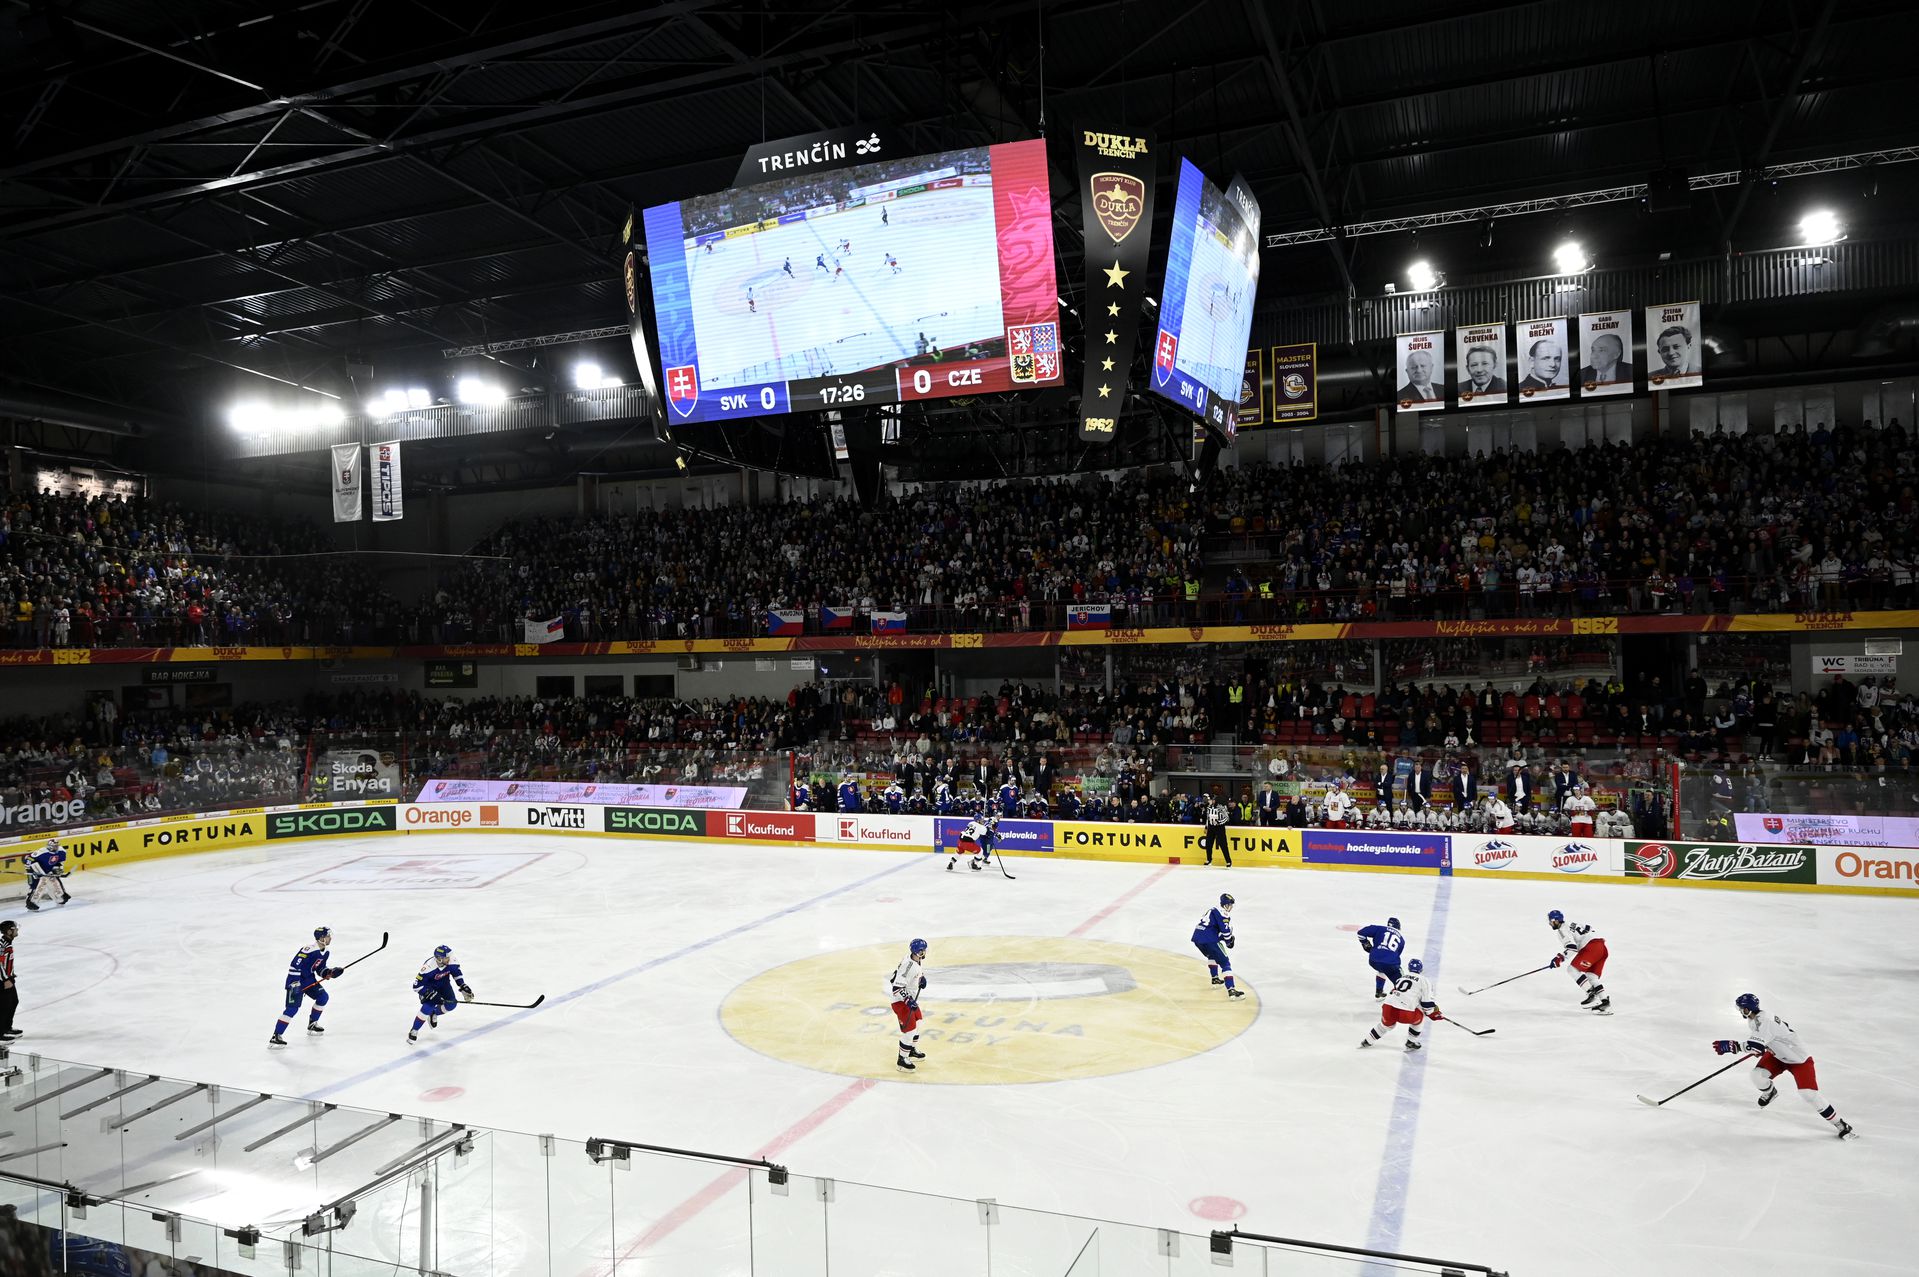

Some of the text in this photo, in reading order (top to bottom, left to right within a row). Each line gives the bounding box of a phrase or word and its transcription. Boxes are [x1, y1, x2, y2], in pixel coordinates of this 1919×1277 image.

[1084, 131, 1148, 153] DUKLA
[758, 140, 846, 172] TRENČÍN
[1100, 200, 1136, 212] DUKLA
[1277, 354, 1311, 363] MAJSTER
[720, 369, 982, 410] SVK 0 17:26 0 CZE
[1181, 381, 1193, 400] SVK
[1196, 386, 1203, 408] 0
[1085, 418, 1114, 432] 1962
[381, 464, 392, 513] TIPOS
[1794, 611, 1854, 623] DUKLA
[1104, 629, 1145, 638] DUKLA
[1250, 624, 1294, 634] DUKLA
[1543, 620, 1559, 632] od
[1570, 617, 1619, 635] 1962
[723, 639, 754, 647] DUKLA
[950, 633, 983, 648] 1962
[51, 649, 90, 665] 1962
[213, 648, 247, 656] DUKLA
[514, 644, 540, 656] 1962
[1822, 658, 1844, 666] WC
[152, 671, 210, 680] BAR HOKEJKA
[332, 761, 373, 774] Škoda
[333, 776, 390, 794] Enyaq
[406, 808, 472, 826] Orange
[144, 822, 252, 848] FORTUNA
[748, 823, 794, 837] Kaufland
[861, 828, 911, 840] Kaufland
[1064, 831, 1162, 848] FORTUNA
[1184, 835, 1290, 852] FOTUNA
[1475, 850, 1518, 865] SLOVAKIA
[1552, 852, 1598, 868] SLOVAKIA
[1732, 845, 1804, 872] Bažant
[1381, 932, 1400, 952] 16
[825, 1002, 1085, 1036] FOTUNA
